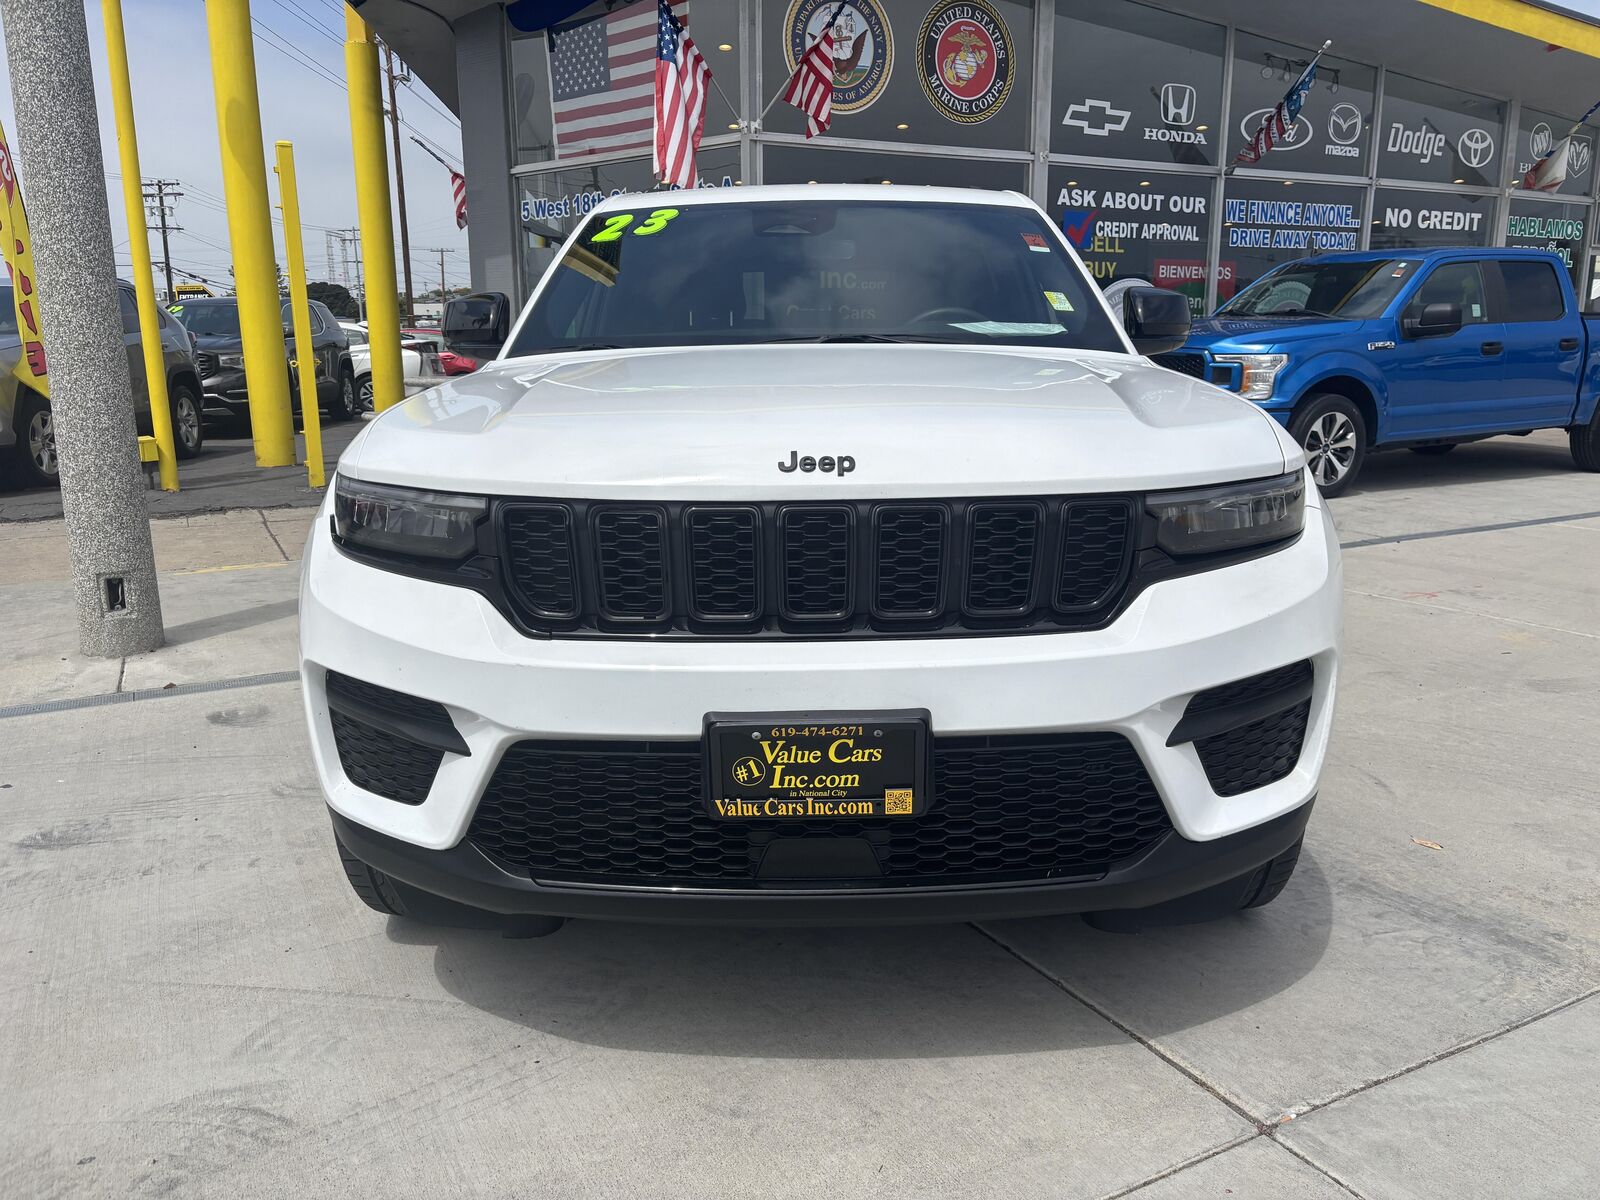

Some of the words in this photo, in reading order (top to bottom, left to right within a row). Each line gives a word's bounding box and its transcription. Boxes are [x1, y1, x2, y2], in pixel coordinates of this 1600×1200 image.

[869, 16, 884, 43] NAVY
[931, 7, 972, 39] UNITED
[973, 9, 1006, 60] STATES
[845, 91, 857, 100] OF
[859, 59, 883, 96] AMERICA
[929, 73, 970, 113] MARINE
[972, 79, 1004, 112] CORPS
[1143, 127, 1207, 145] HONDA
[1387, 122, 1445, 163] Dodge
[533, 195, 569, 219] West
[1057, 188, 1097, 207] ASK
[1101, 191, 1165, 212] ABOUT
[1169, 195, 1206, 214] OUR
[591, 208, 680, 242] 23
[1225, 199, 1246, 223] WE
[1247, 200, 1302, 226] FINANCE
[1302, 203, 1360, 228] ANYONE...
[1384, 207, 1412, 229] NO
[1417, 209, 1482, 231] CREDIT
[1095, 220, 1139, 239] CREDIT
[1141, 223, 1199, 242] APPROVAL
[1229, 228, 1270, 248] DRIVE
[1271, 229, 1311, 249] AWAY
[1311, 231, 1357, 250] TODAY!
[1507, 216, 1584, 240] HABLAMOS
[1159, 264, 1232, 280] BIENVENOS
[777, 451, 856, 477] Jeep
[771, 726, 864, 737] 619-474-6271
[759, 740, 821, 764] Value
[828, 738, 882, 764] Cars
[735, 759, 763, 783] #1
[769, 765, 860, 789] Inc.com
[789, 789, 797, 797] in
[799, 789, 830, 797] National
[831, 789, 847, 798] City
[715, 799, 761, 817] Value
[764, 797, 803, 816] Cars
[807, 797, 873, 815] Inc.com
